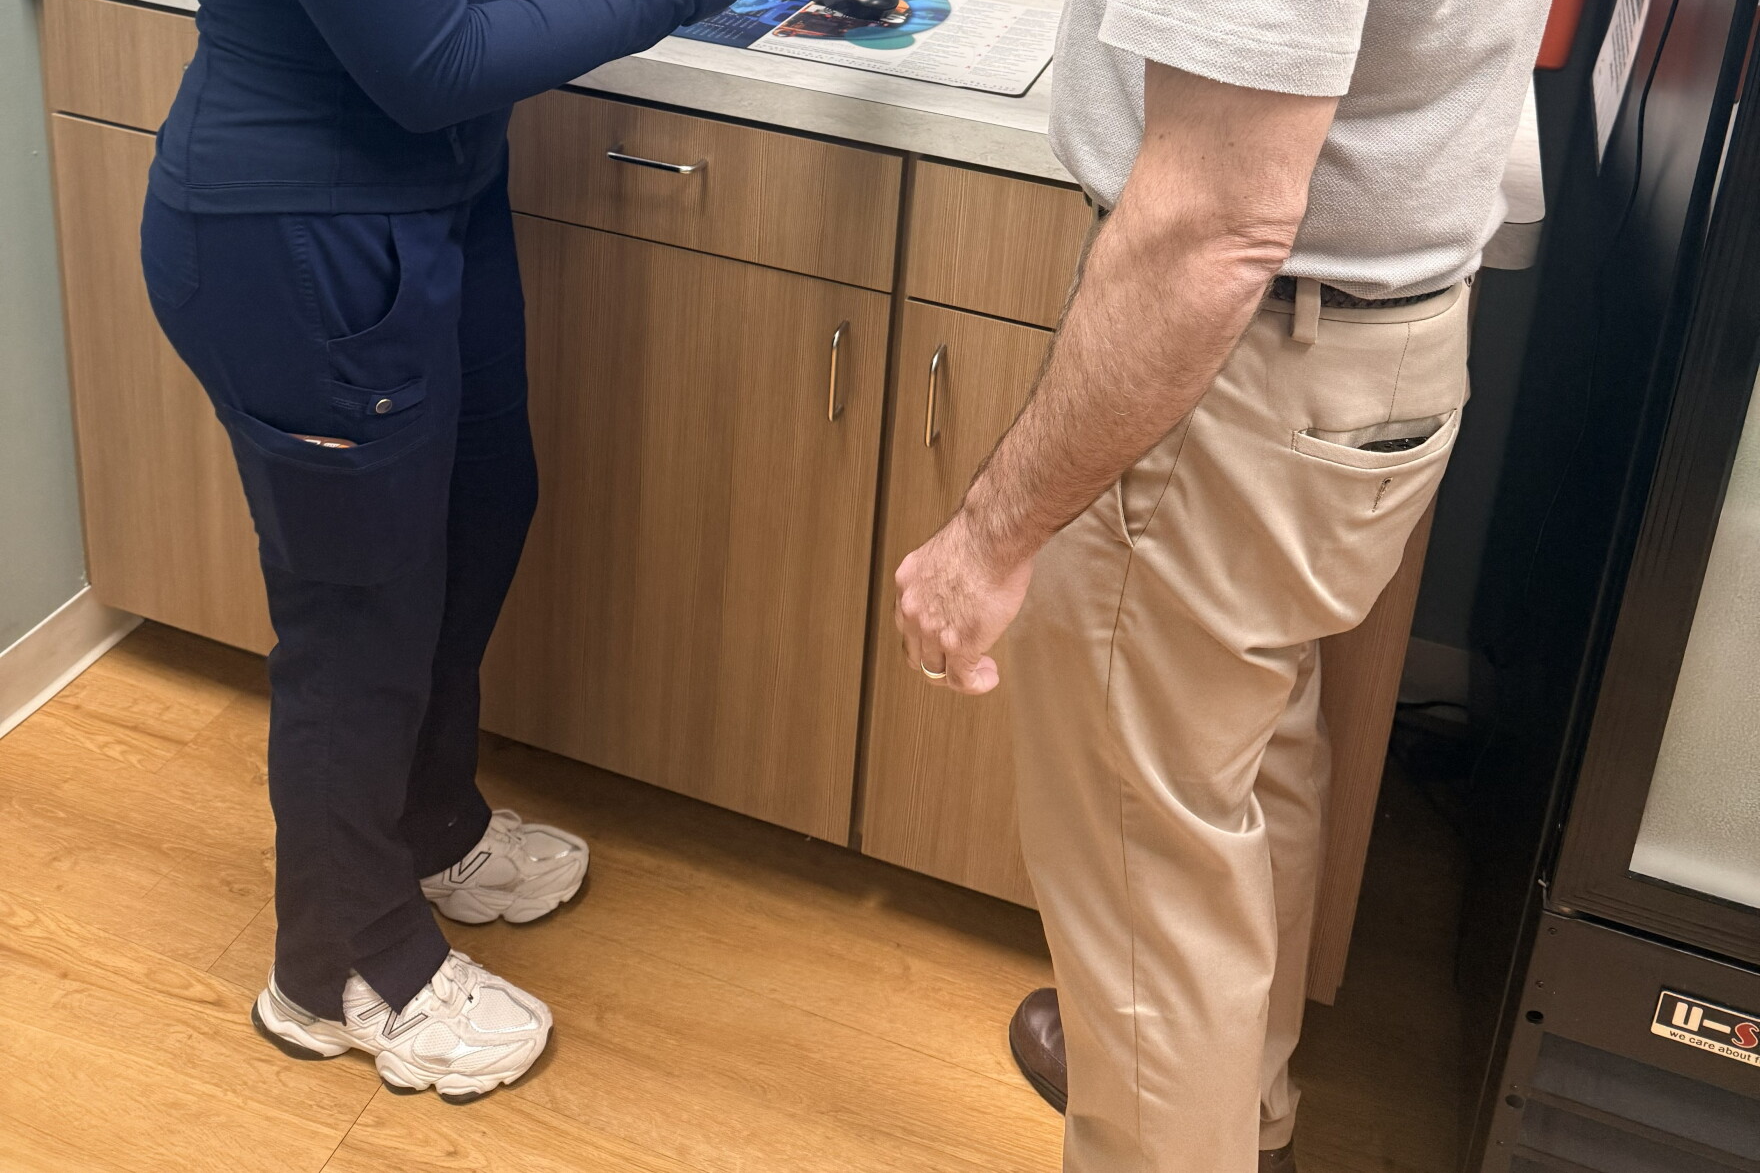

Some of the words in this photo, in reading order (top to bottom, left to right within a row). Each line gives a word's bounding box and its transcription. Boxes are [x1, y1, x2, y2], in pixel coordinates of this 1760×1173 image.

[1669, 1030, 1686, 1041] we
[1689, 1036, 1716, 1050] care
[1718, 1046, 1751, 1062] about
